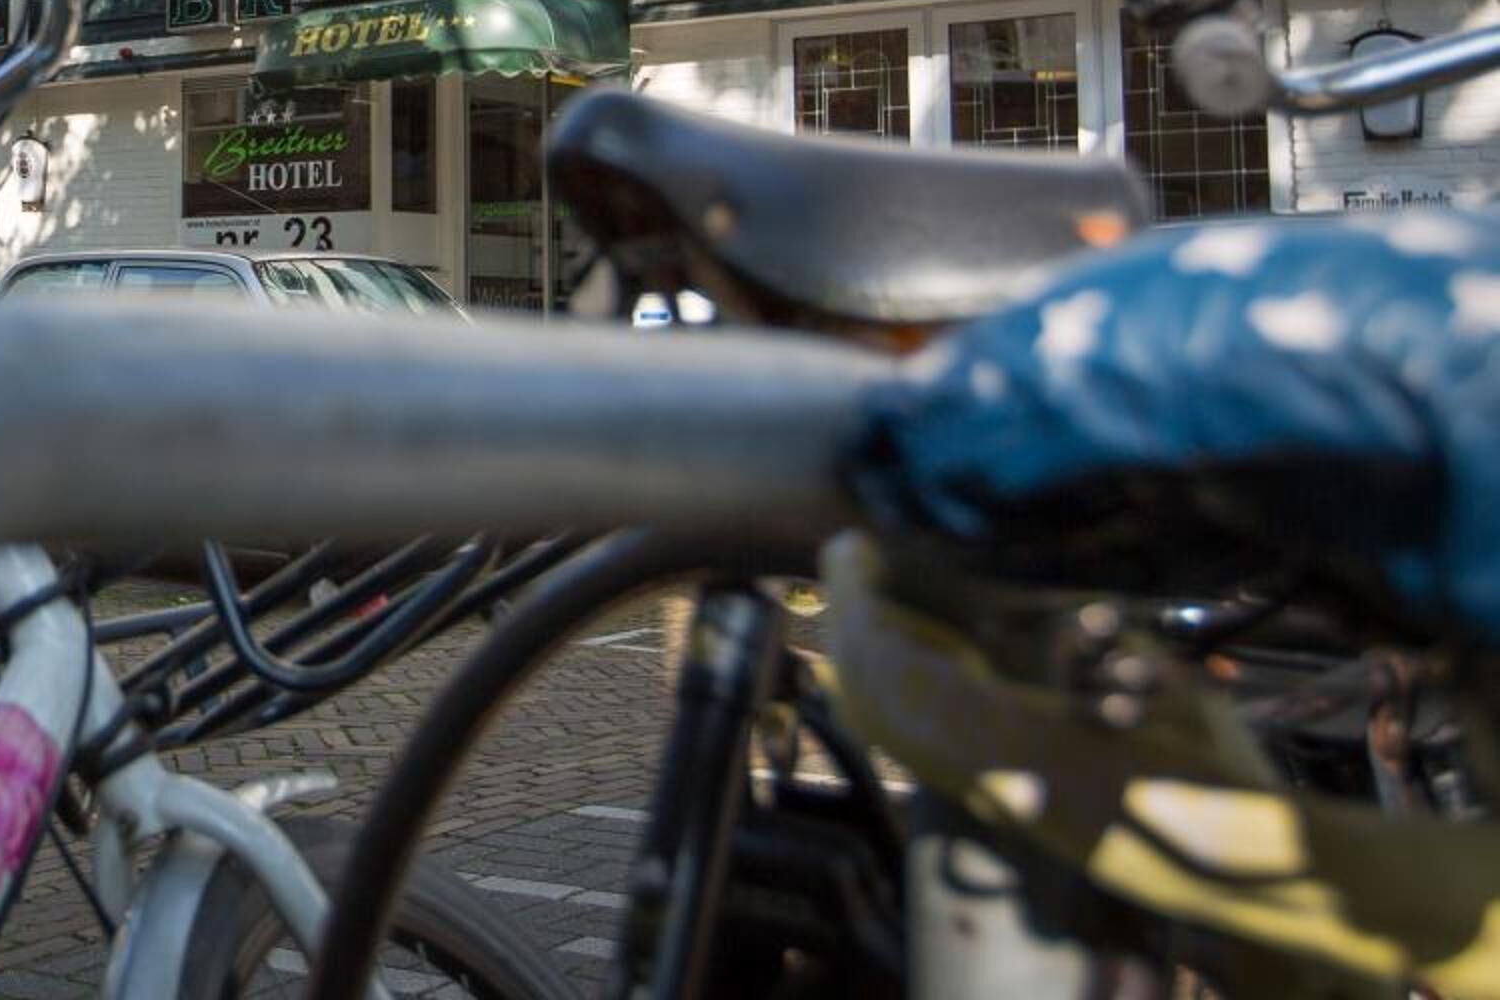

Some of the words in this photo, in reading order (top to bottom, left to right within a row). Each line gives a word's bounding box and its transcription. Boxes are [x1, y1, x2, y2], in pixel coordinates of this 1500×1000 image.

[290, 11, 430, 57] HOTEL
[204, 124, 349, 178] Breitner
[248, 160, 342, 191] HOTEL
[284, 216, 333, 250] 23
